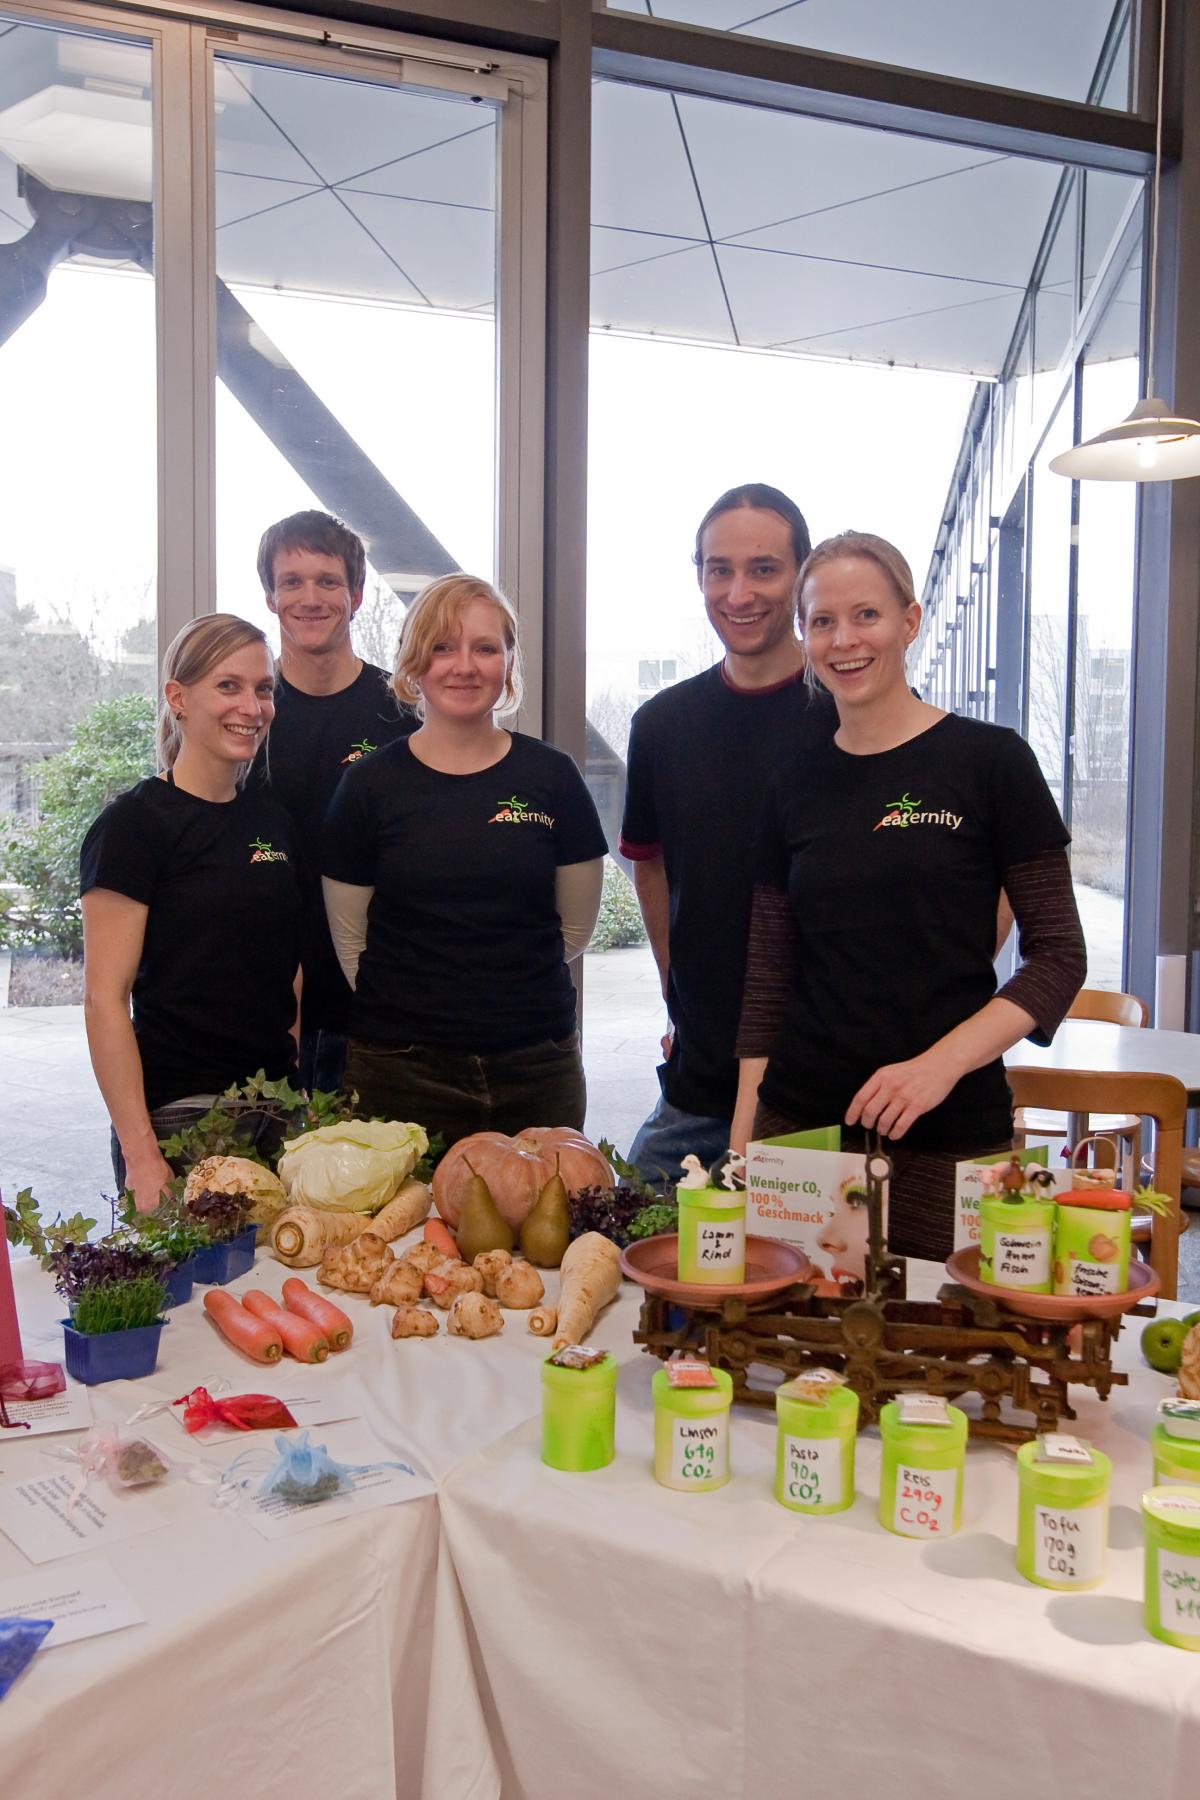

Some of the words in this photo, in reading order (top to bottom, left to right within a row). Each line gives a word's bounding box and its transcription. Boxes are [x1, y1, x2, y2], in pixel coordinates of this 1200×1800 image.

[494, 808, 555, 830] eaternity
[881, 809, 964, 830] eaternity
[749, 1175, 801, 1194] Weniger
[756, 1205, 825, 1225] Geschmack
[701, 1229, 735, 1240] Lamm
[701, 1248, 733, 1261] Rind
[680, 1427, 718, 1440] Linsen
[790, 1444, 820, 1460] Pasta
[790, 1461, 820, 1489] 90g
[901, 1486, 943, 1512] 290g
[1039, 1512, 1080, 1532] Tofu
